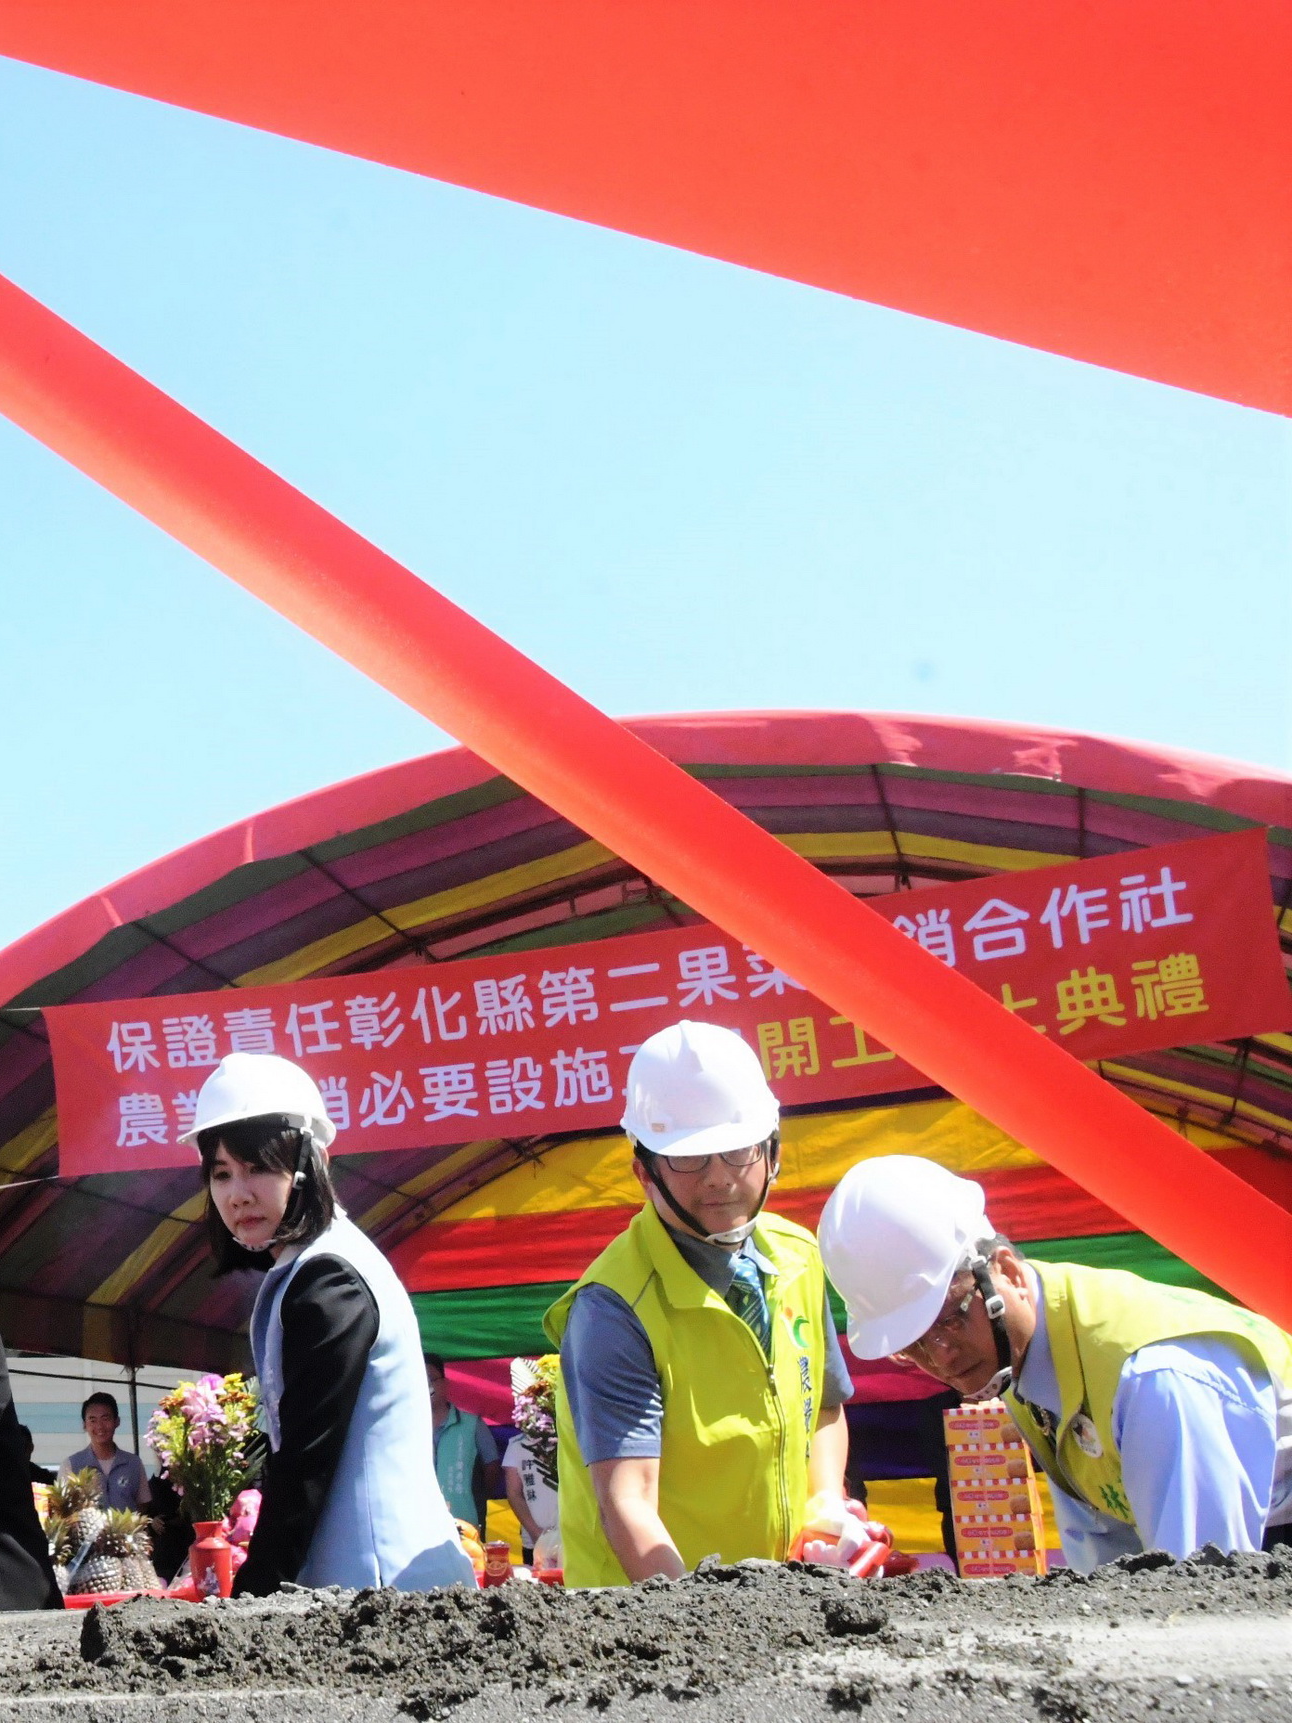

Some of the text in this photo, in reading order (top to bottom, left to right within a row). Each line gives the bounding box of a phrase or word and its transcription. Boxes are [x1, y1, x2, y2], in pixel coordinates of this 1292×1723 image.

[107, 866, 1194, 1074] 保證責任彰化縣第二果菜銷合作社
